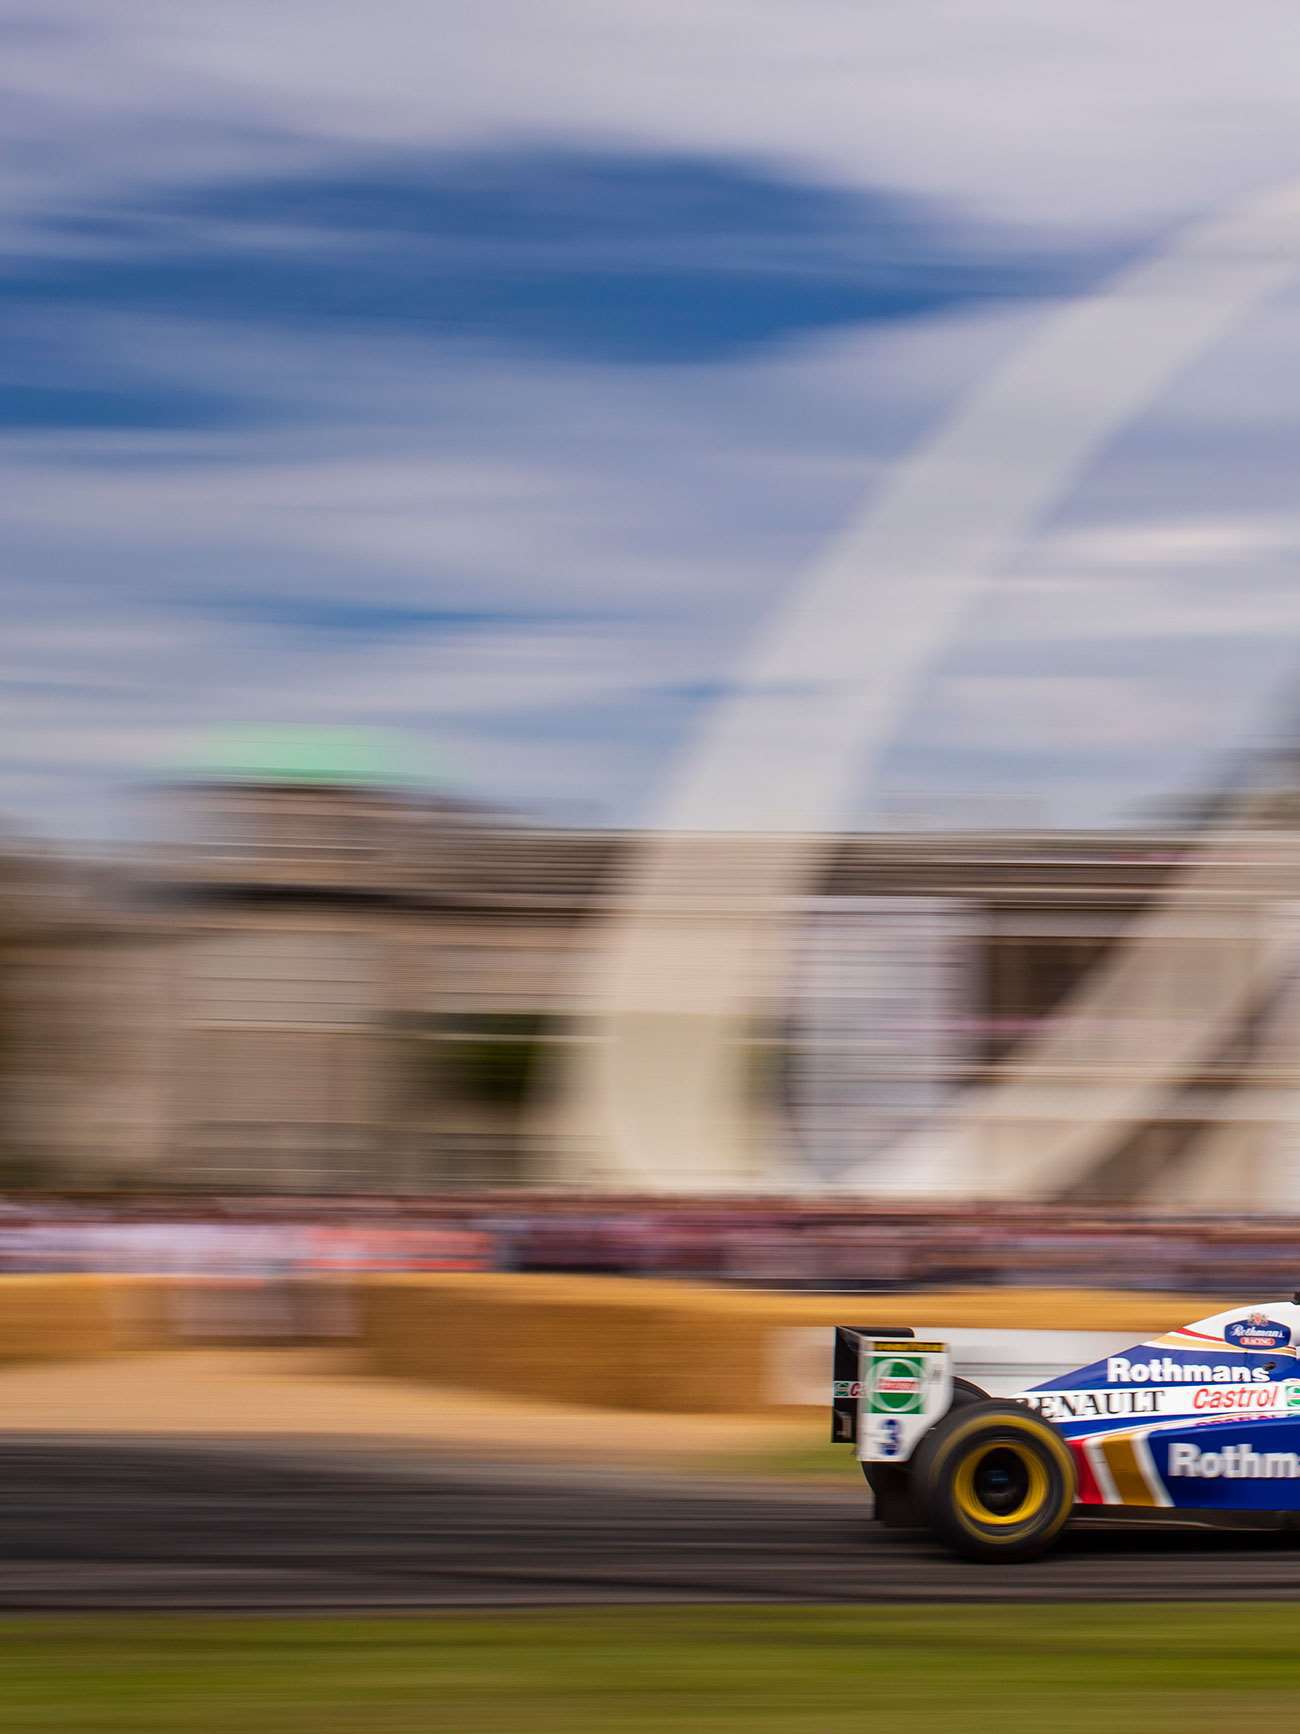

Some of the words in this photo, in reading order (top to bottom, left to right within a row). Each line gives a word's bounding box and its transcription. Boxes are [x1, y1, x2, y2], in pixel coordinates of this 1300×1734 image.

[1232, 1324, 1285, 1338] Rothmans
[1107, 1358, 1270, 1382] Rothmans
[1192, 1385, 1279, 1409] Castrol
